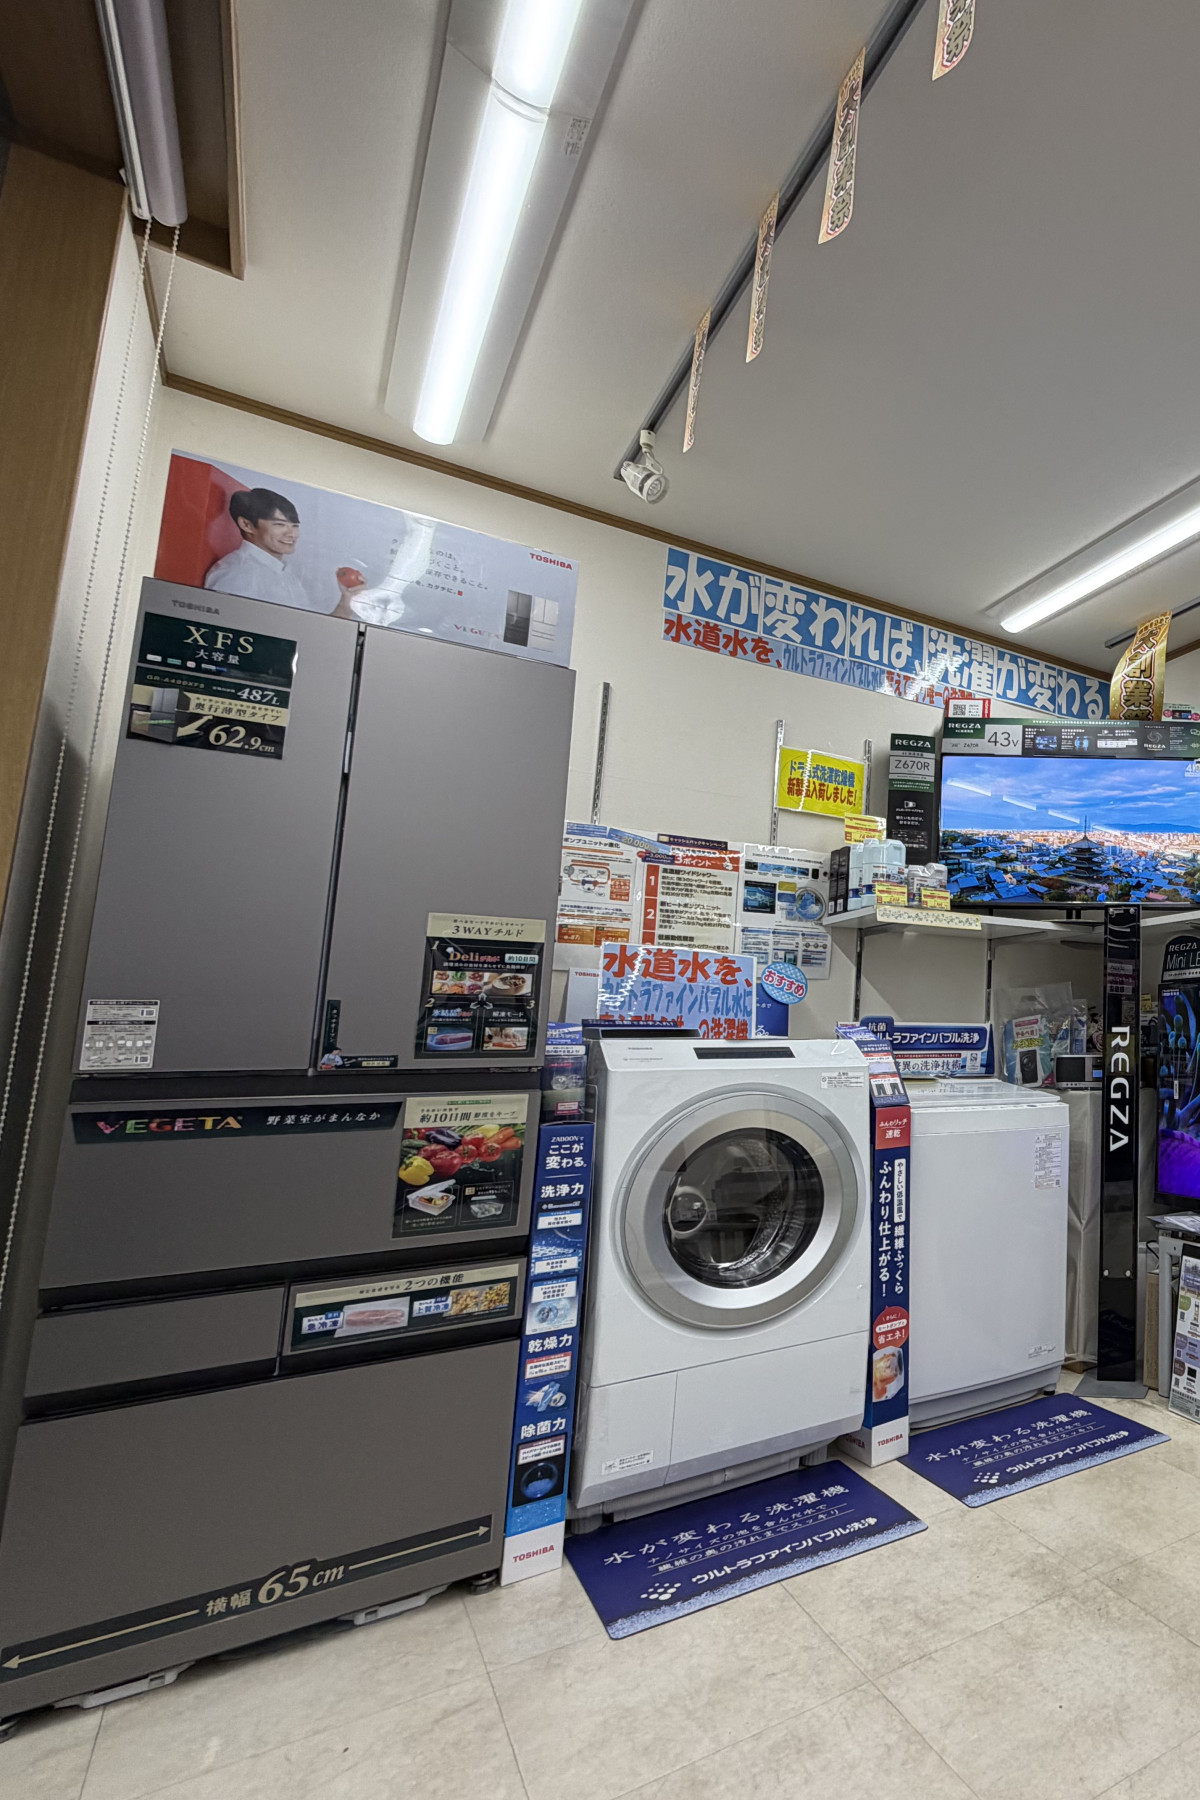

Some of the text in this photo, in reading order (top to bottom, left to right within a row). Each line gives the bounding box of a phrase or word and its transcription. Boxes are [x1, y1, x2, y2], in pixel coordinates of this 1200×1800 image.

[529, 552, 573, 571] TOSHIBA
[171, 600, 220, 616] TOSHIBA
[183, 625, 254, 655] XFS
[195, 649, 240, 665] 大容量
[237, 687, 280, 706] 487L
[208, 724, 275, 753] 62.9cm
[894, 738, 932, 748] REGZA
[894, 759, 930, 771] Z670R
[1169, 942, 1198, 952] REGZA
[602, 944, 753, 988] 水道水を、
[1166, 953, 1187, 970] Mini
[762, 968, 806, 998] おすすめ
[868, 1022, 887, 1032] 抗菌
[876, 1031, 980, 1045] ルトラファインバブル洗浄
[1109, 1025, 1131, 1152] REGZA
[96, 1115, 242, 1135] VEGETA
[266, 1112, 382, 1127] 野菜室がまんなか
[419, 1112, 472, 1124] 約10日間
[549, 1143, 584, 1154] ここが
[545, 1155, 587, 1170] 変わる。
[540, 1182, 585, 1199] 洗浄力
[403, 1273, 465, 1292] 2つの機能
[528, 1333, 573, 1354] 乾燥力
[520, 1417, 567, 1440] 除菌力
[925, 1409, 1092, 1463] 水が変わる洗濯機
[877, 1433, 904, 1447] TOSHIBA
[1006, 1430, 1129, 1474] ウルトラファインバブル洗浄
[604, 1484, 850, 1566] 水が変わる洗濯機
[513, 1544, 555, 1563] TOSHIBA
[691, 1516, 878, 1584] ウルトラファインバブル洗浄
[205, 1562, 346, 1618] 横幅 65cm
